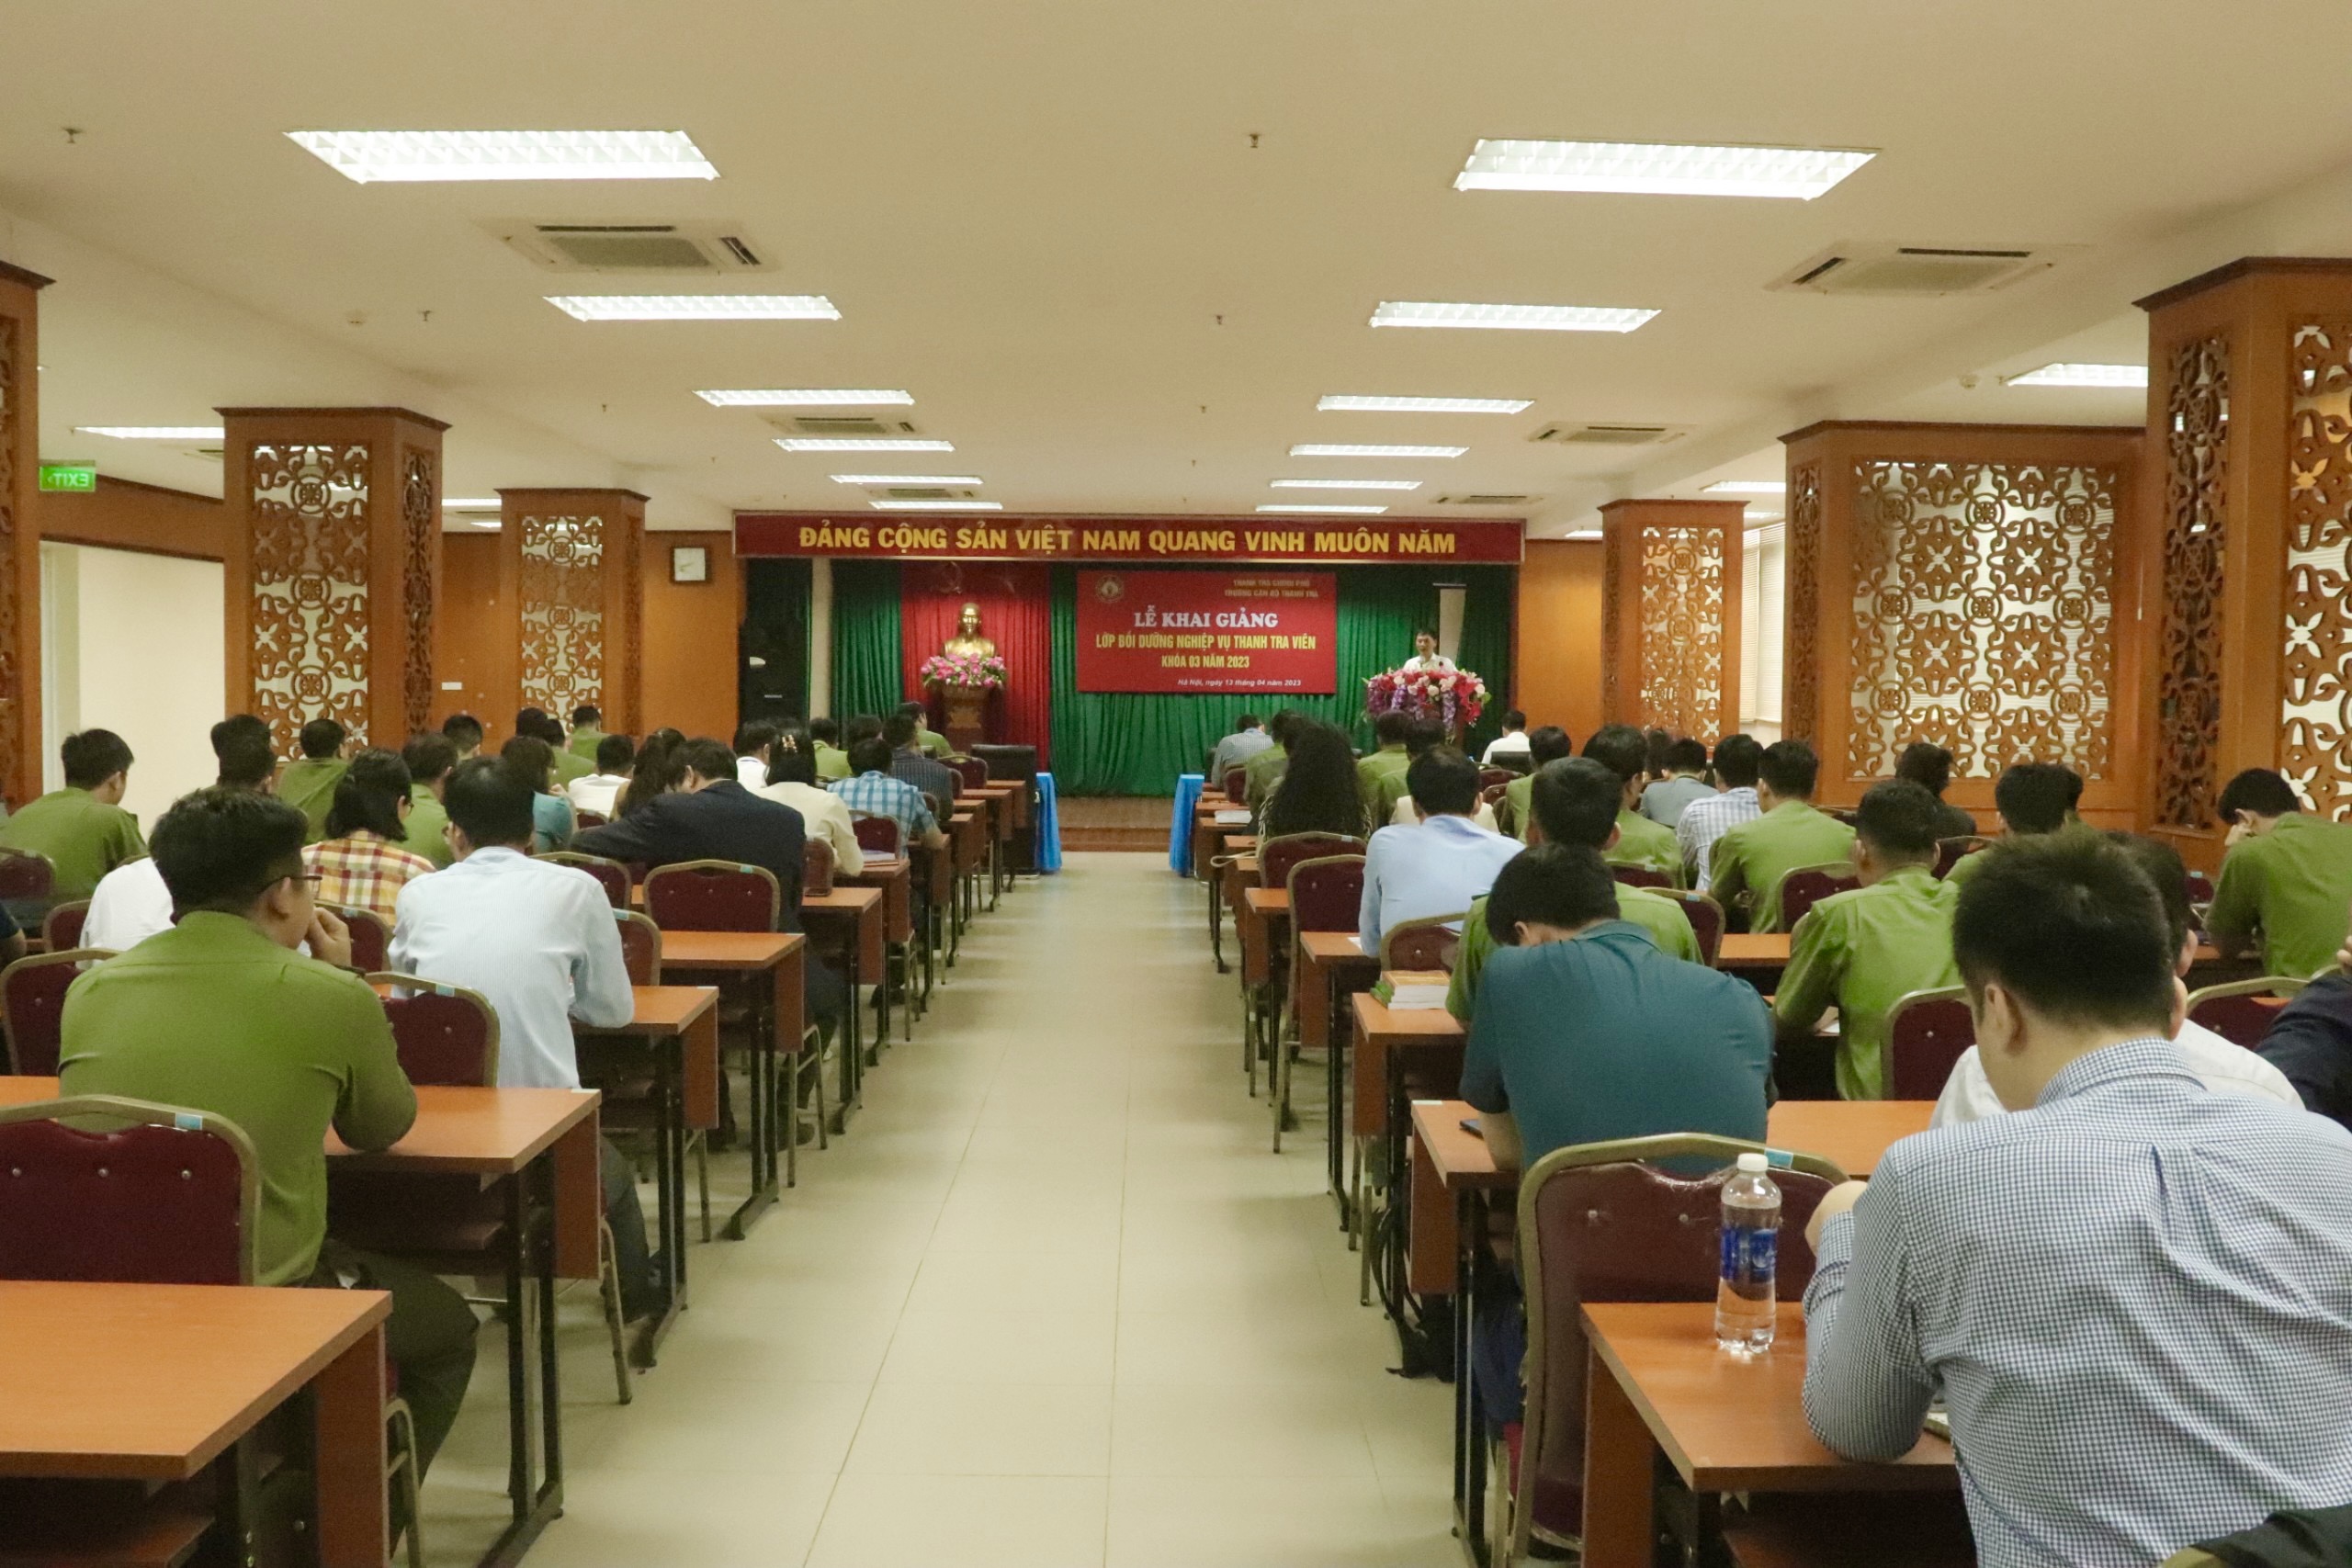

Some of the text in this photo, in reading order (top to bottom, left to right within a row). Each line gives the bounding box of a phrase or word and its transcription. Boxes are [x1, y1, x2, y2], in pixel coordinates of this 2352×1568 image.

[799, 519, 1455, 555] ĐẢNG CỘNG SẢN VIỆT NAM QUANG VINH MUÔN NĂM
[1134, 605, 1279, 628] LỄ KHAI GIẢNG
[1177, 632, 1216, 651] NGHIỆP
[1217, 635, 1231, 651] VỤ
[1234, 635, 1268, 649] THANH
[1270, 635, 1289, 649] TRA
[1292, 633, 1317, 649] VIÊN
[1161, 653, 1250, 669] KHÓA 03 NĂM 2023
[1256, 679, 1265, 687] 04
[1284, 679, 1302, 687] 2023
